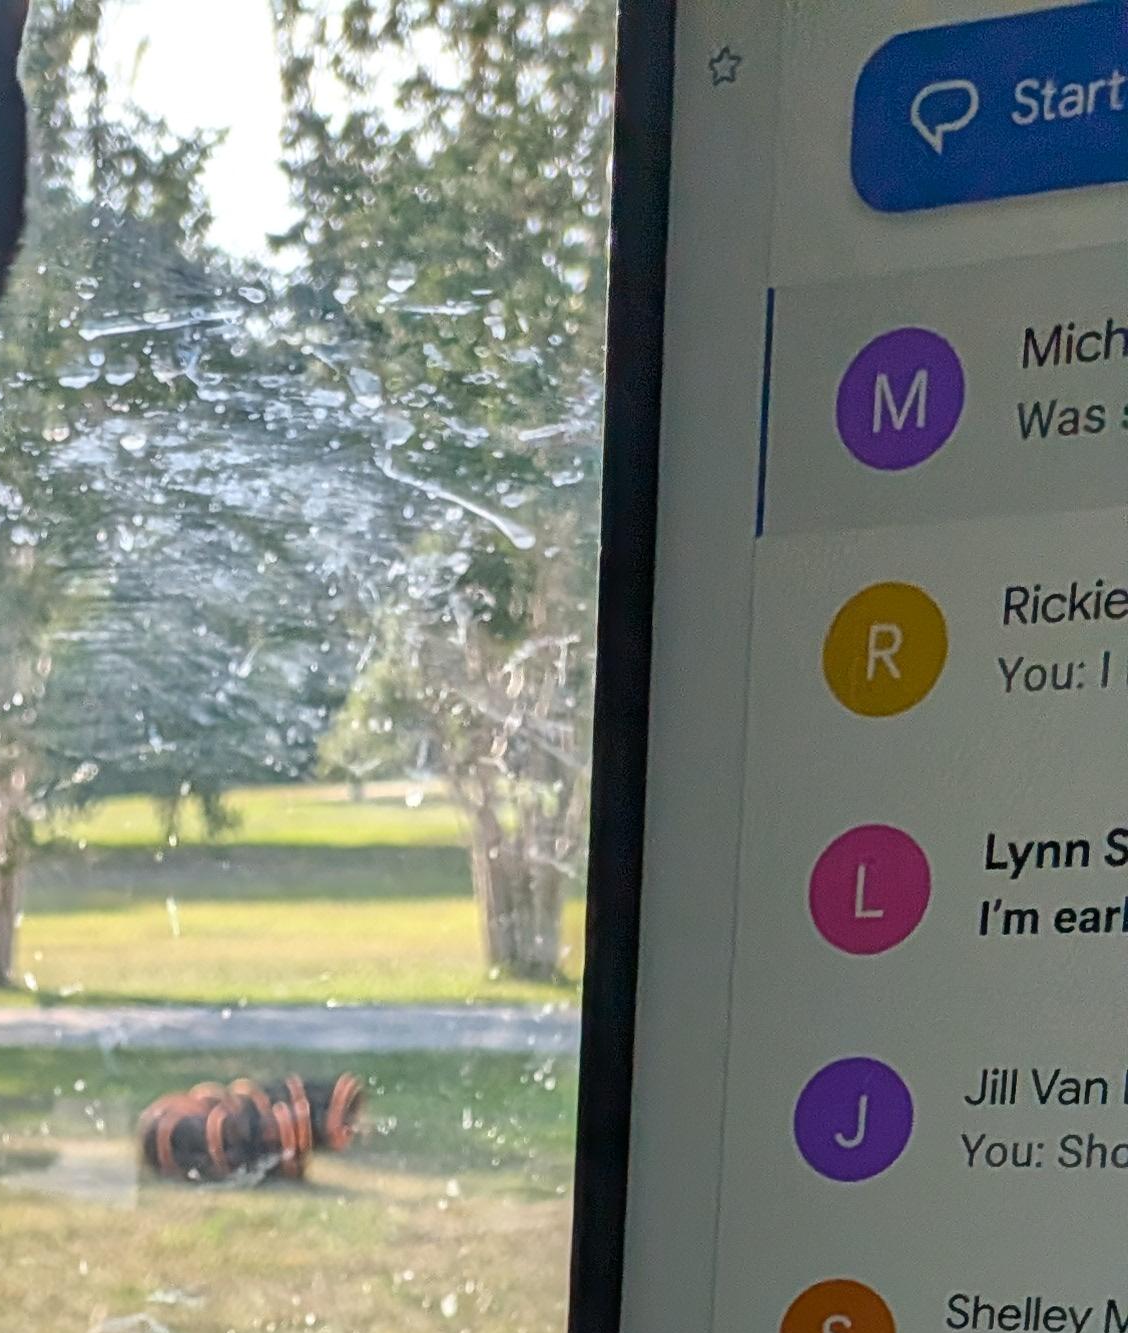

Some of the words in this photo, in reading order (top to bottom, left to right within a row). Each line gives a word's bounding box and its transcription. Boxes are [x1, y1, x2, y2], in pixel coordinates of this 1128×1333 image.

[1010, 69, 1128, 126] Start
[1022, 317, 1128, 370] Mich
[872, 368, 929, 434] M
[1017, 399, 1107, 441] Was
[1002, 577, 1128, 627] Rickie
[865, 622, 904, 682] R
[998, 654, 1085, 694] You:
[984, 832, 1091, 881] Lynn
[854, 863, 885, 919] L
[963, 1067, 1019, 1107] Jill
[1031, 1067, 1110, 1106] Van
[834, 1094, 868, 1149] J
[961, 1132, 1045, 1169] You:
[1057, 1133, 1128, 1170] Sho
